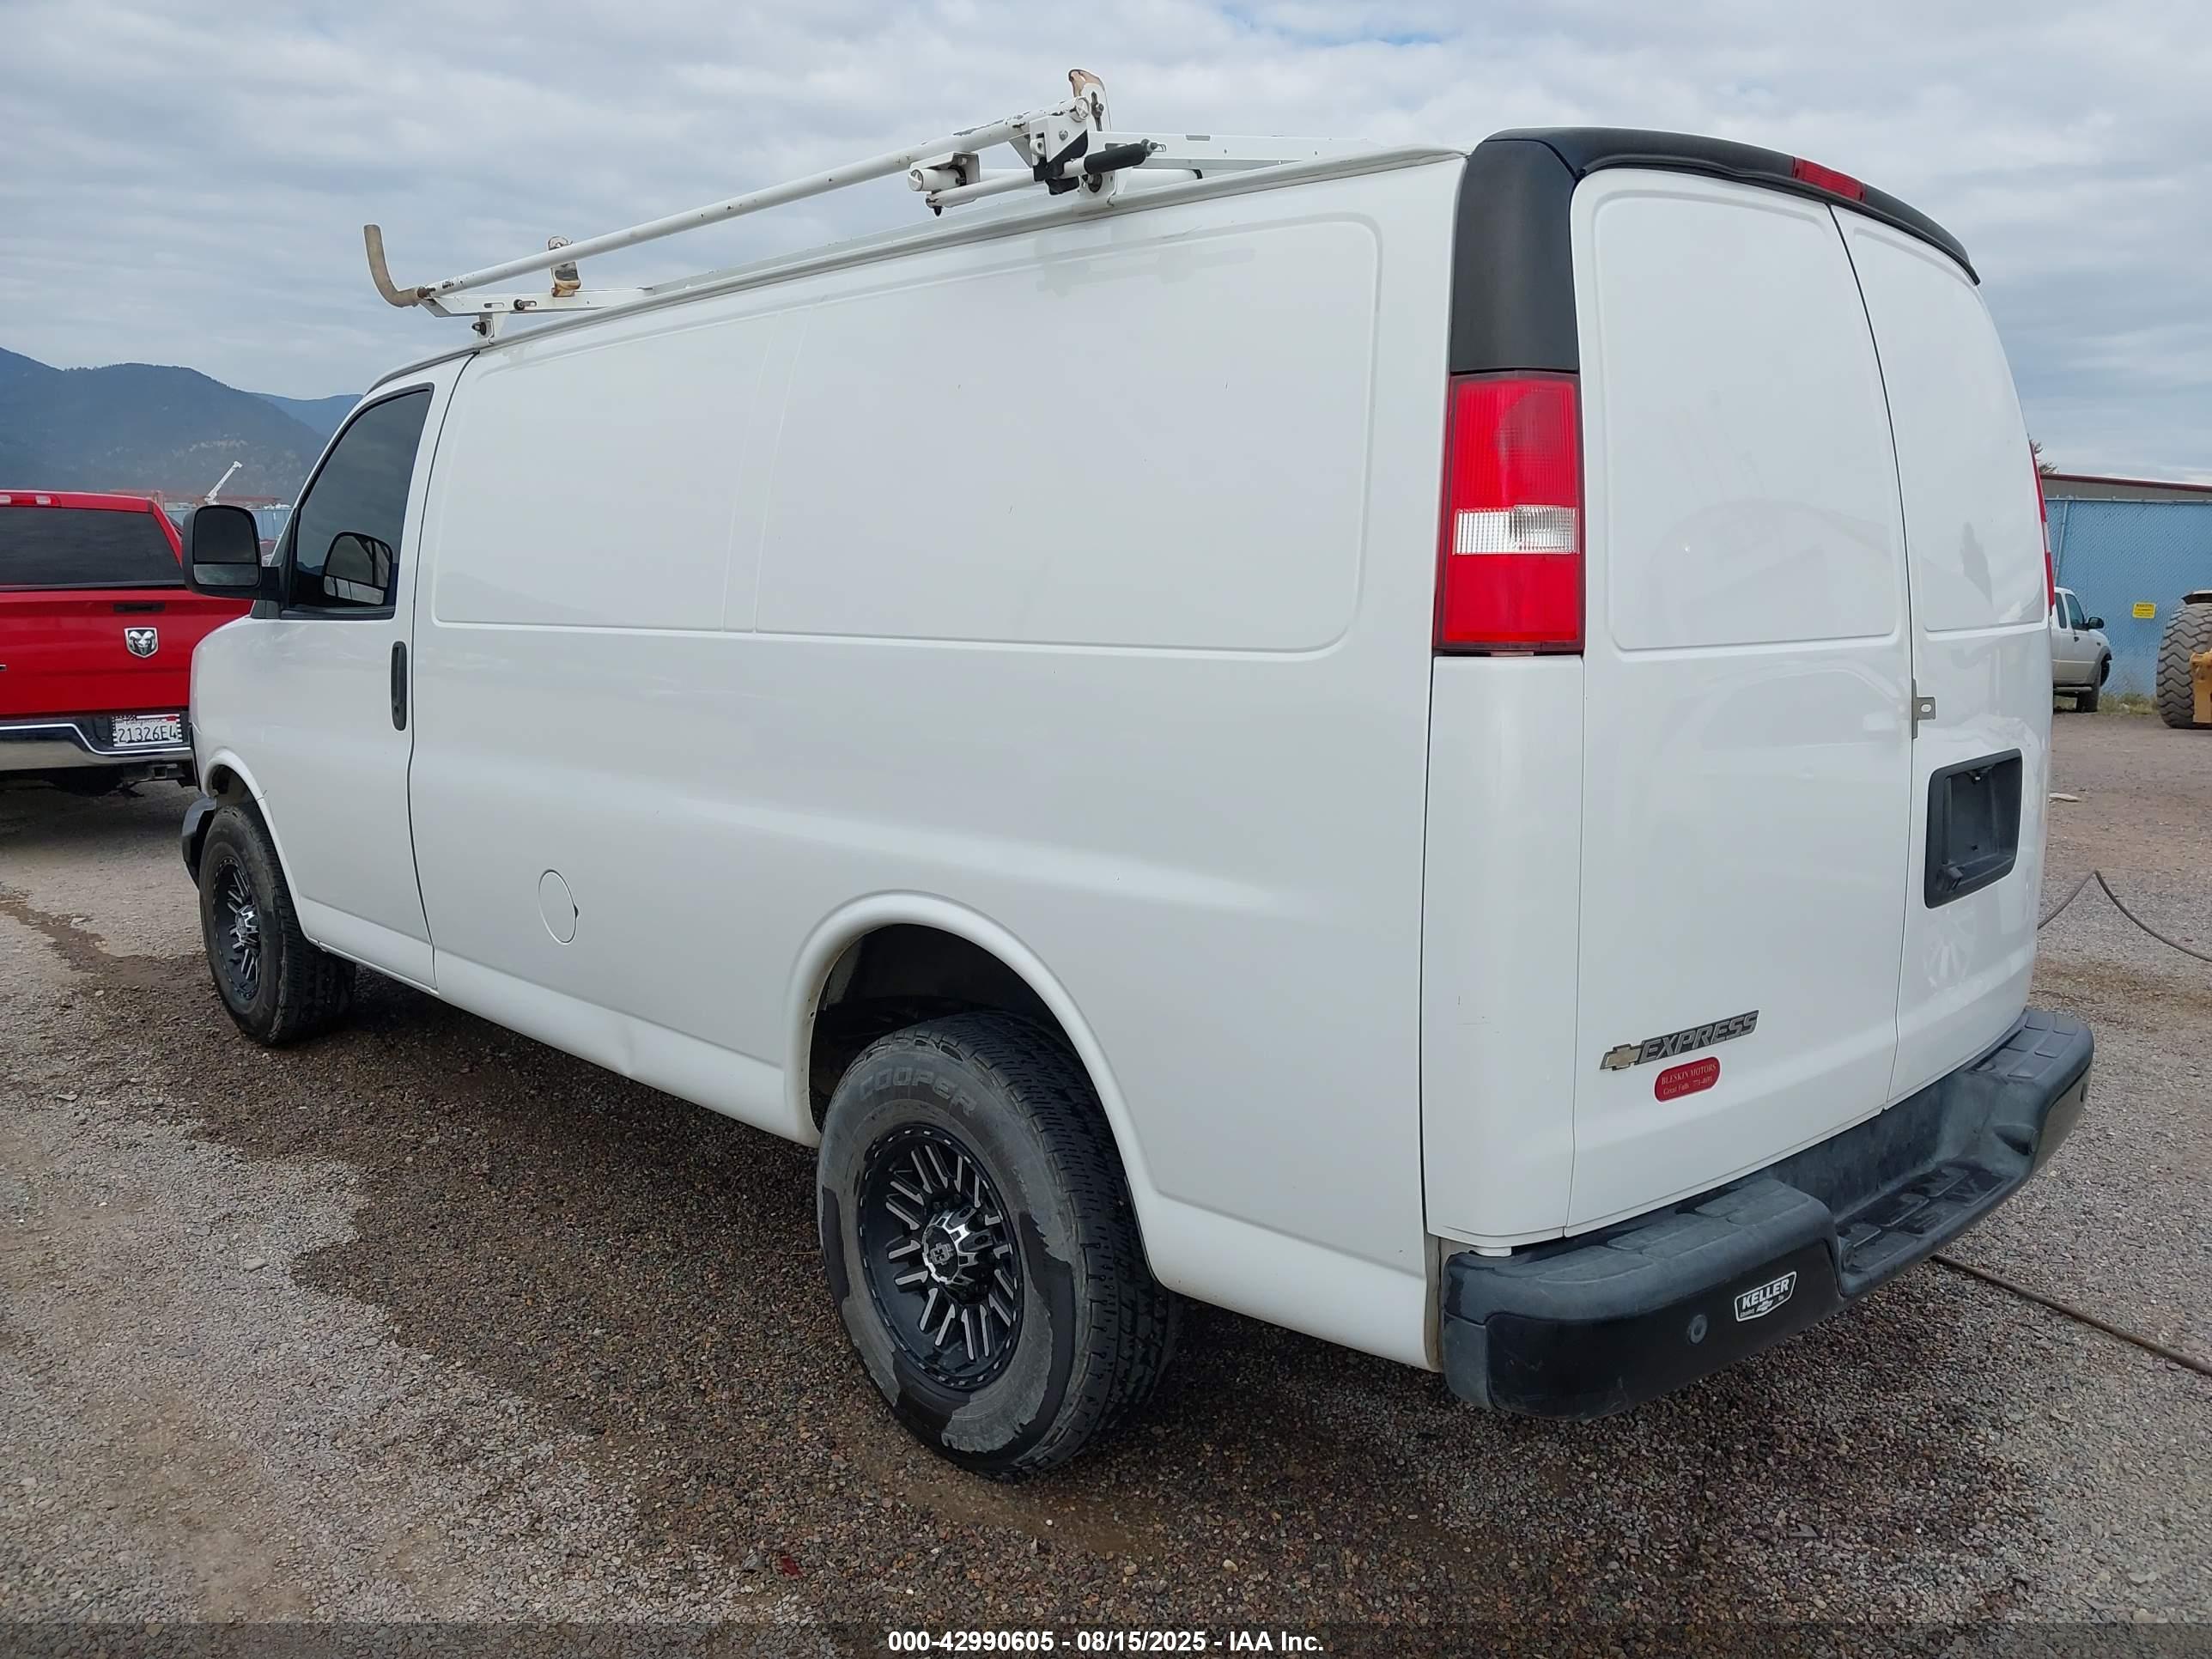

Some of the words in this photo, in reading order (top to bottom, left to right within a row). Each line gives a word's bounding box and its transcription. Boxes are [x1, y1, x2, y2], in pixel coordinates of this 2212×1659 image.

[118, 725, 177, 744] 21326E4
[1638, 1012, 1759, 1064] EXPRESS
[1690, 1064, 1717, 1078] MOTORS
[860, 1066, 977, 1118] COOPER
[1741, 1278, 1790, 1310] KELLER
